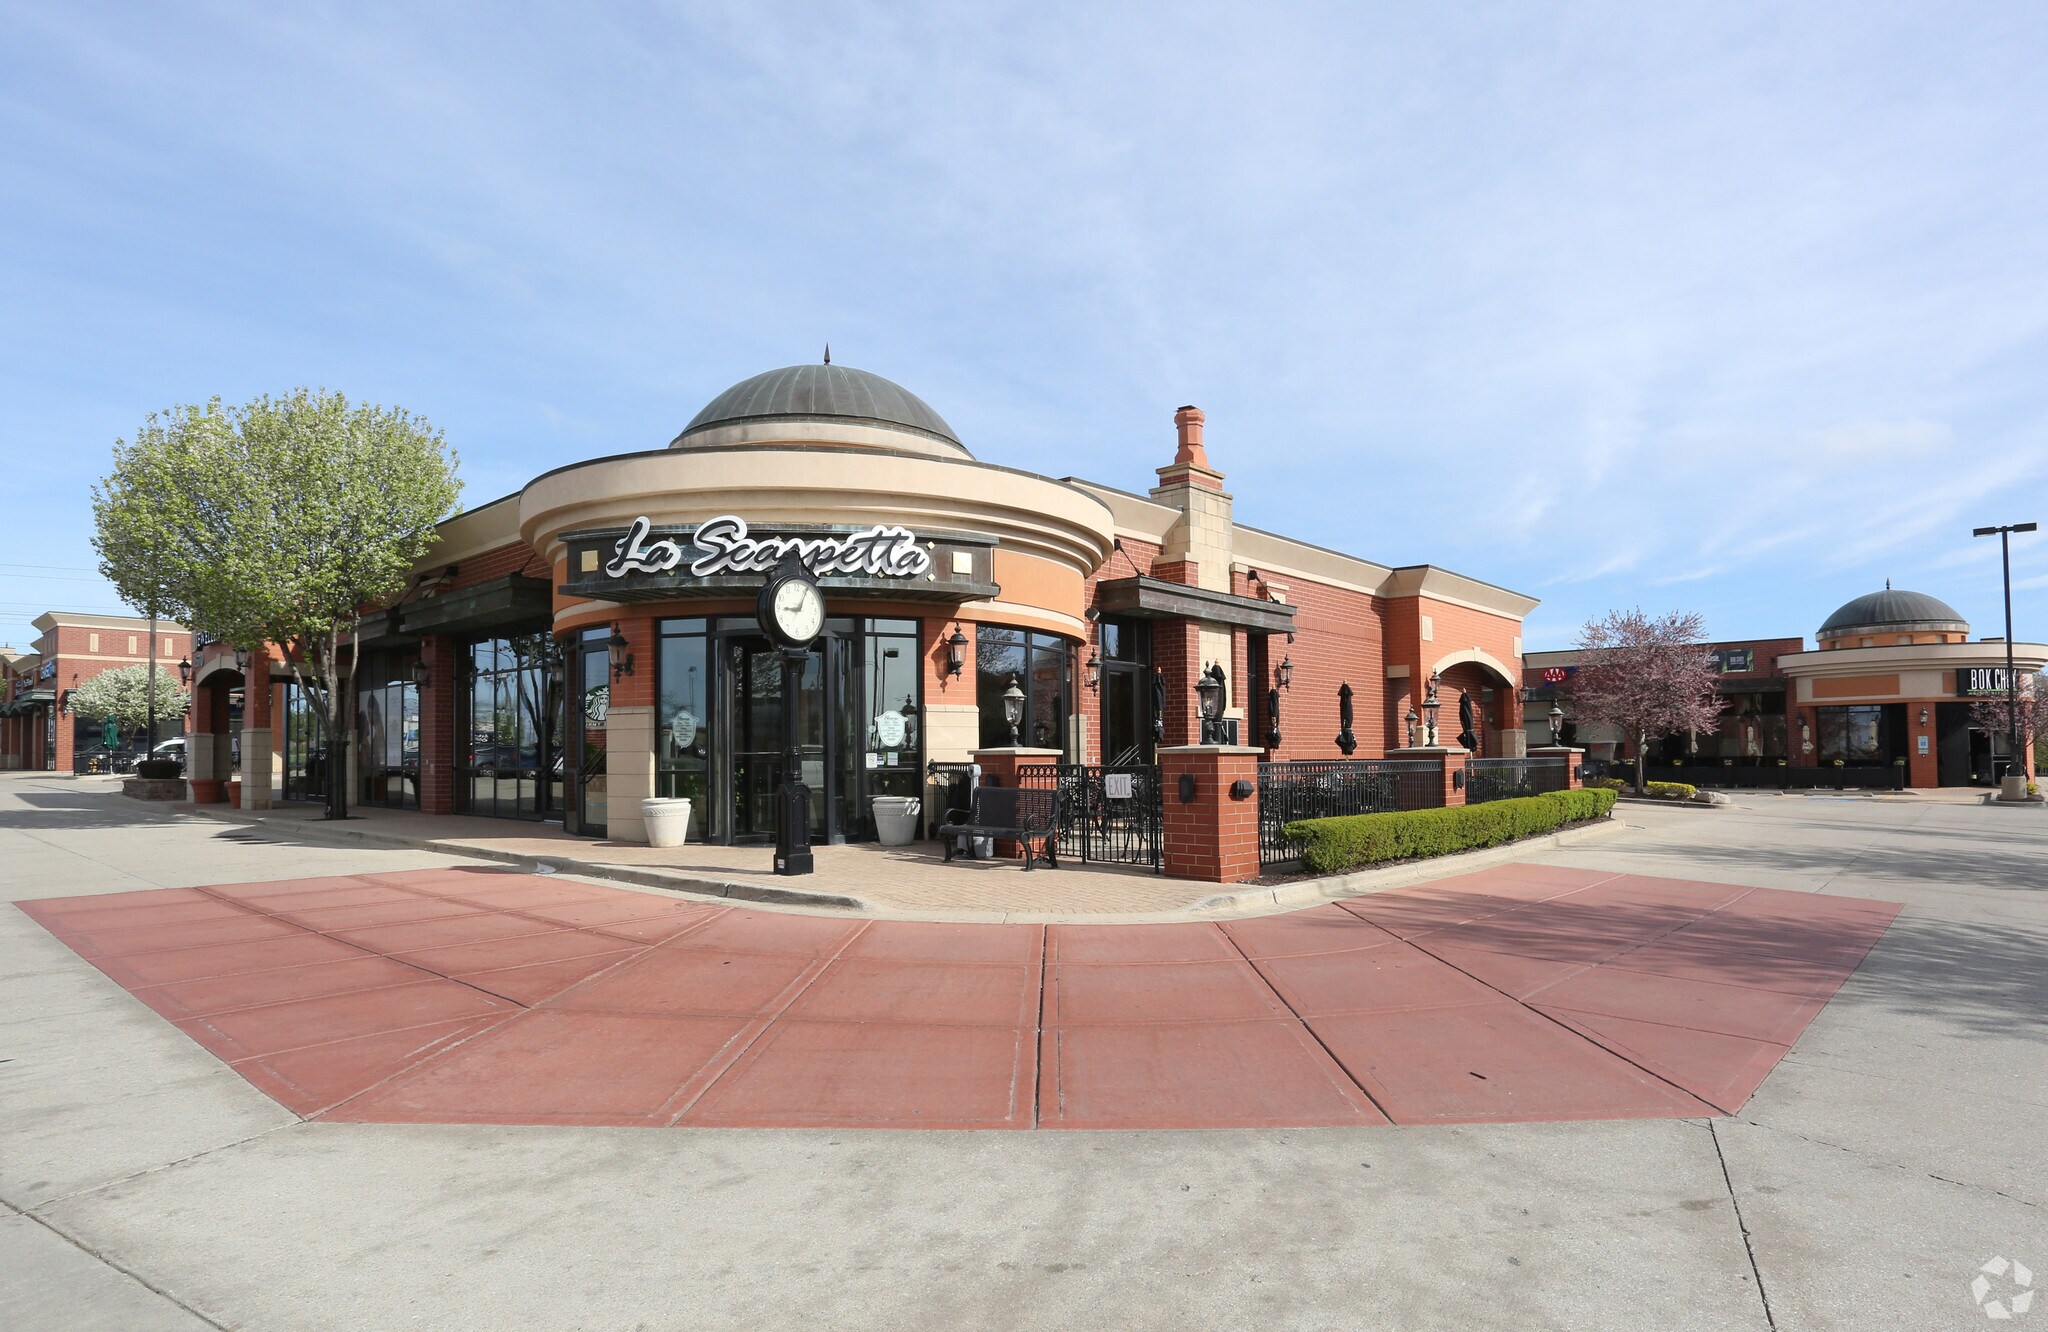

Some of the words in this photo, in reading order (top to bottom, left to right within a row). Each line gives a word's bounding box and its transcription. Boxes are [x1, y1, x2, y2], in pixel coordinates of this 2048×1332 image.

[606, 517, 680, 577] La
[1544, 668, 1565, 682] AAA
[1971, 669, 1992, 690] BOK
